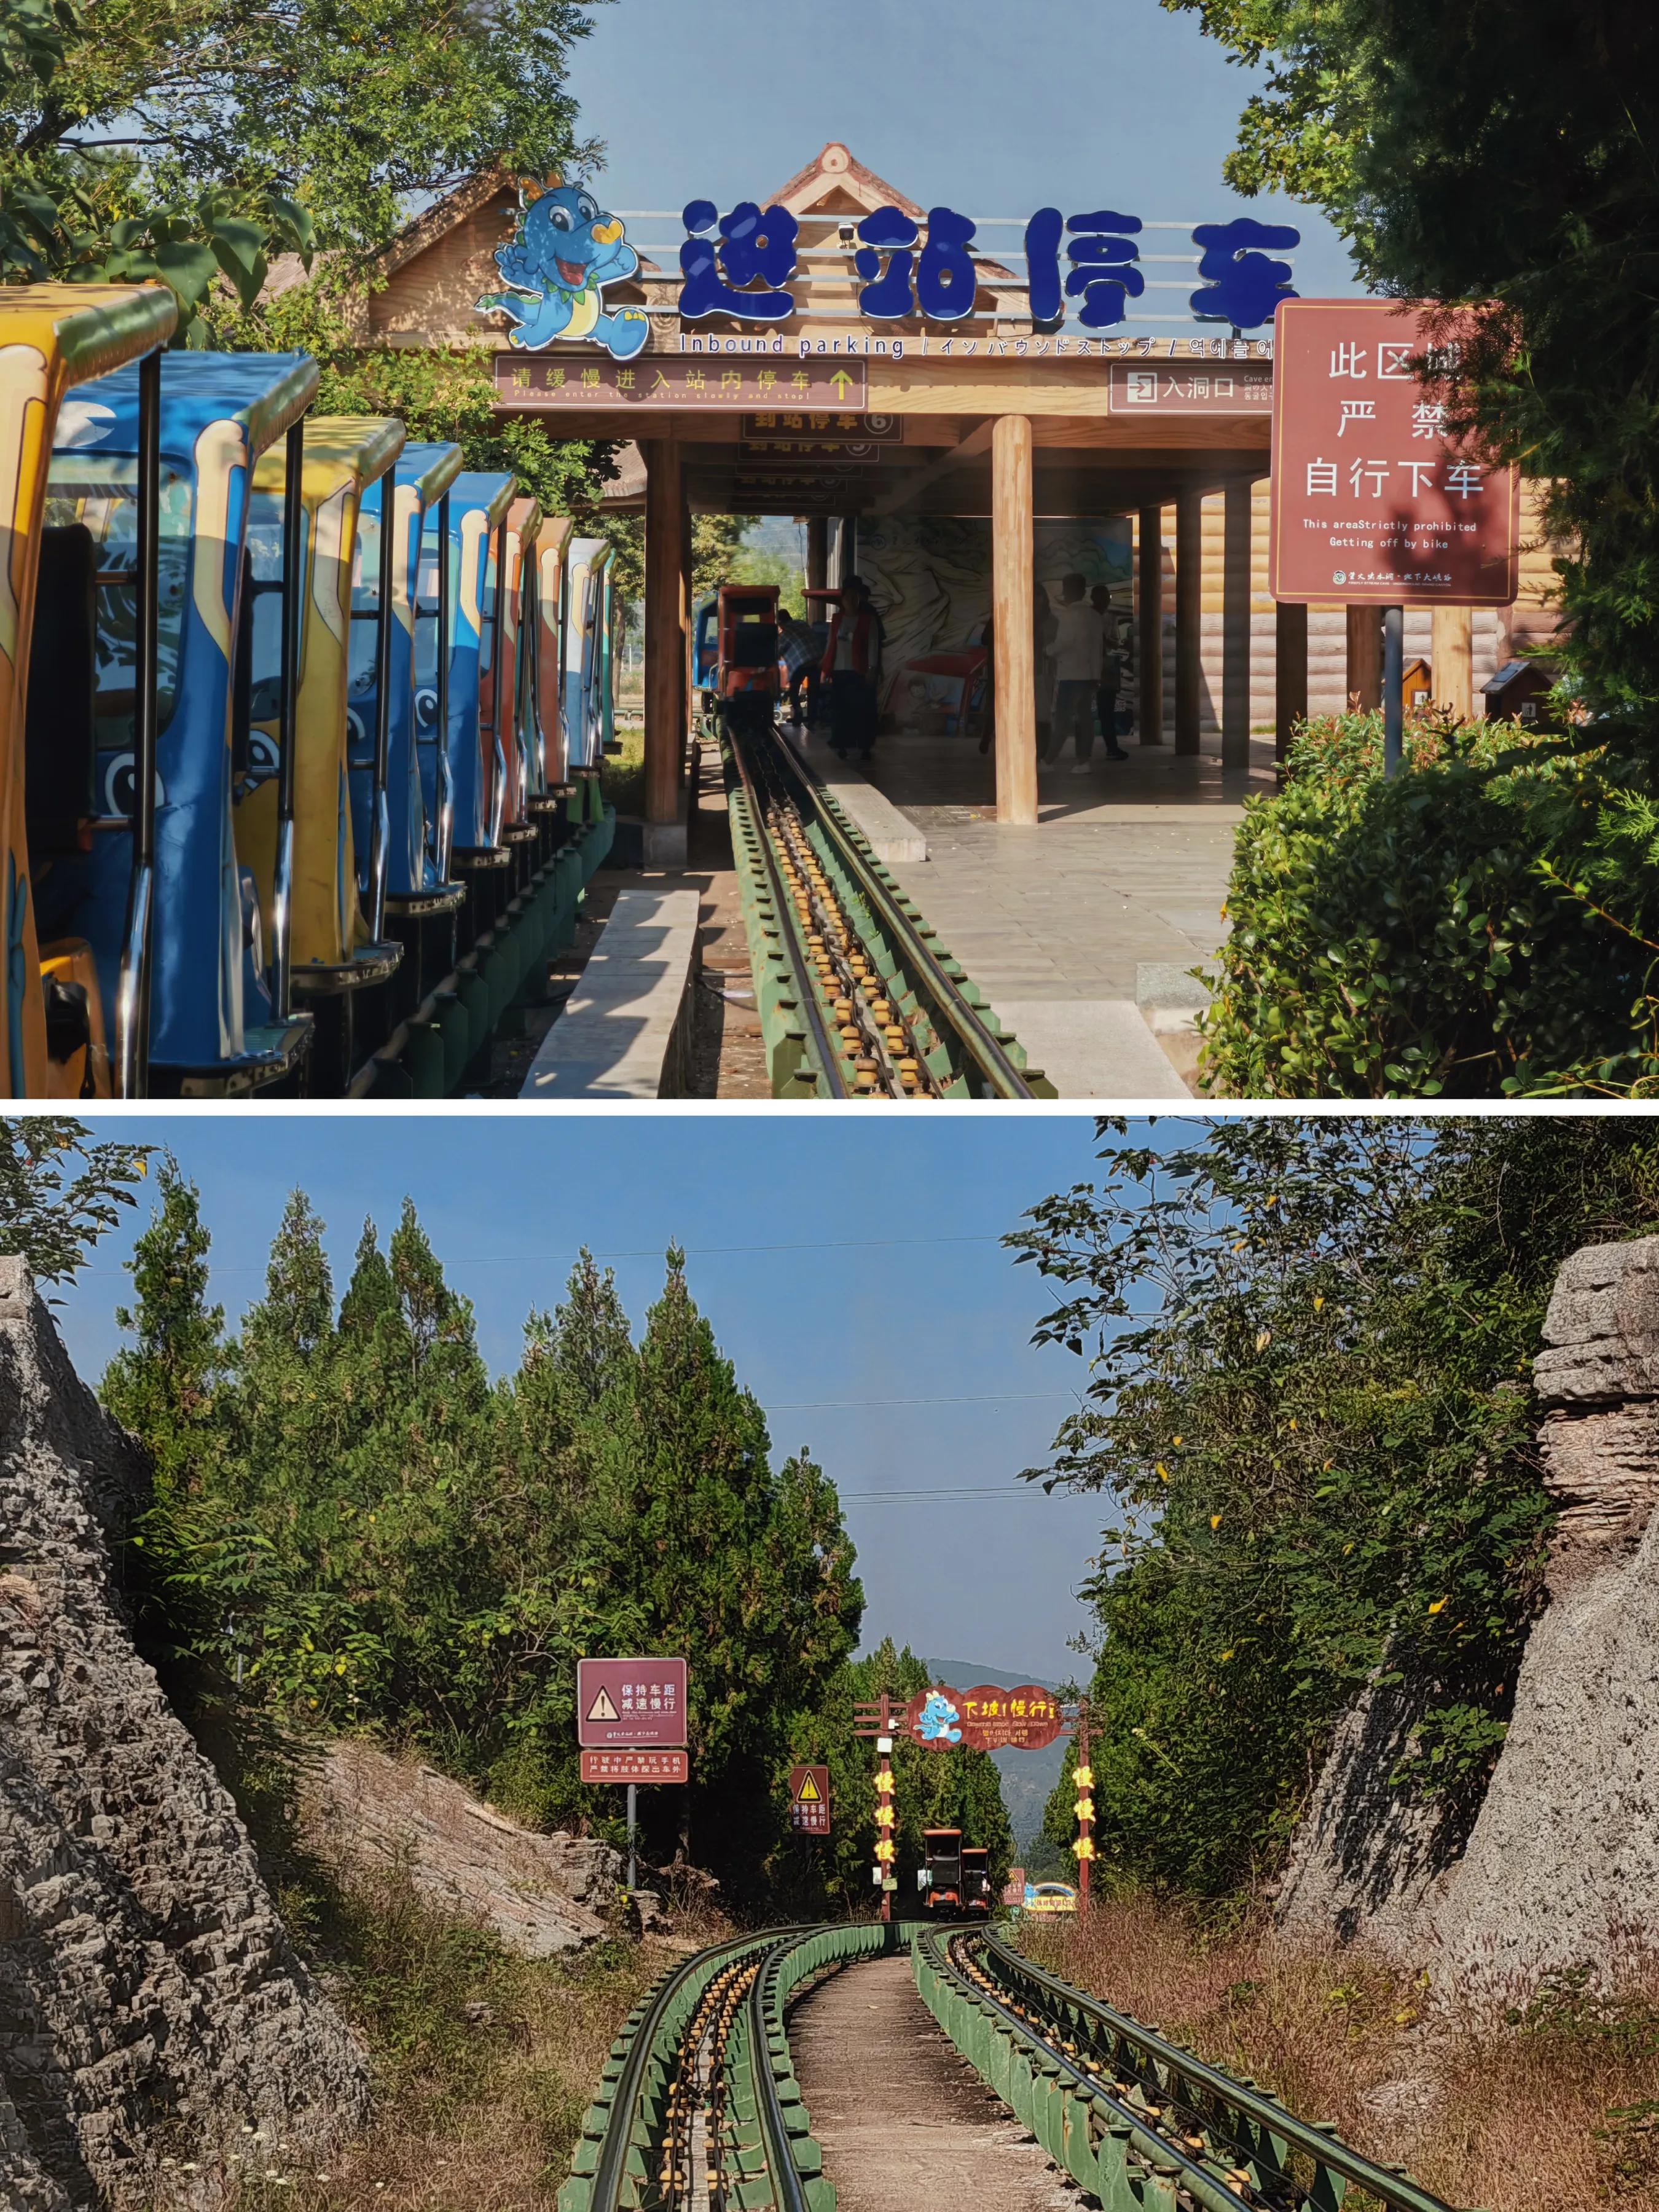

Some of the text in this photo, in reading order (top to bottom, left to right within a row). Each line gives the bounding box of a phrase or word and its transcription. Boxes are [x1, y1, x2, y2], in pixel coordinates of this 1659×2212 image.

[680, 335, 783, 353] Inbound
[799, 336, 904, 358] parking
[939, 337, 1156, 356] インバウンドストップ
[511, 367, 809, 390] 请缓慢进入站内停车
[1163, 376, 1234, 399] 入洞口
[755, 413, 858, 429] 到站停车
[1337, 400, 1449, 439] 严禁
[1306, 457, 1484, 500] 自行下车
[1303, 519, 1477, 531] This areaStrictly prohibited
[1330, 536, 1448, 549] Getting off by bike
[621, 1684, 676, 1696] 保持车距
[621, 1698, 676, 1710] 减速慢行
